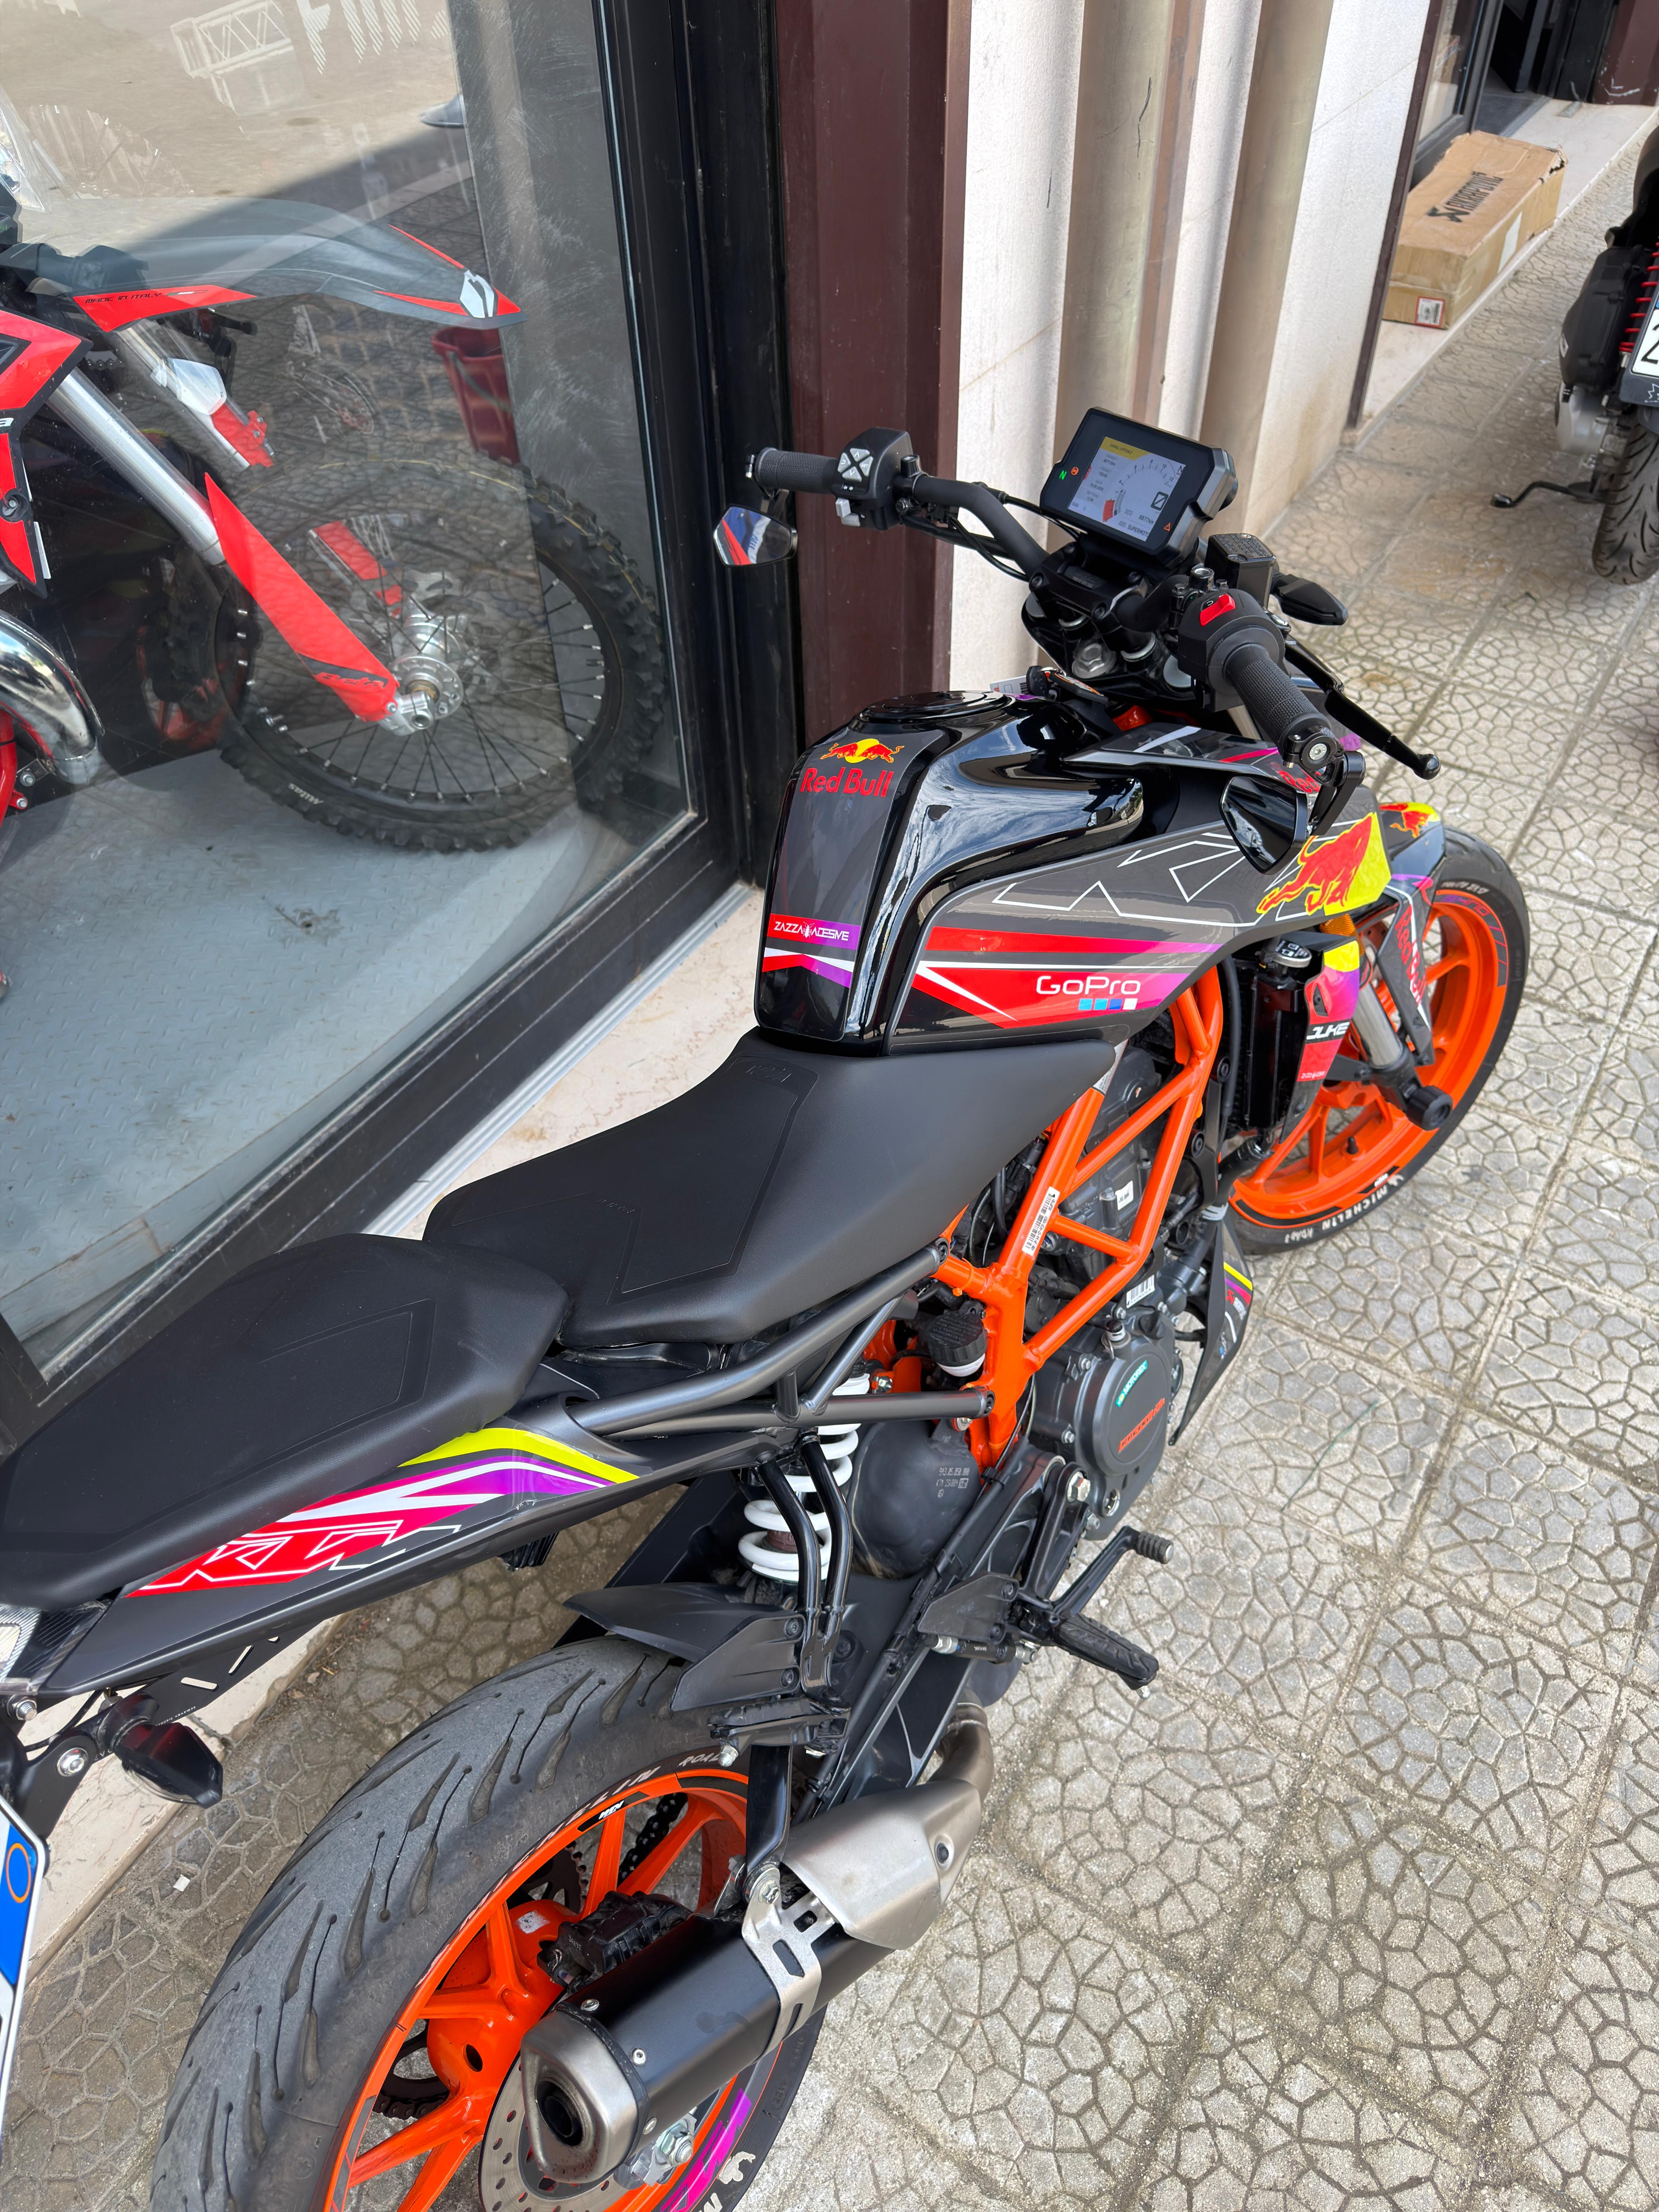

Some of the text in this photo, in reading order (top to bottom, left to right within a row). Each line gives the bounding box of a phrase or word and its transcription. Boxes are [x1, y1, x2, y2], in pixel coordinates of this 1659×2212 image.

[800, 767, 894, 798] Red Bull
[1395, 903, 1417, 965] Red
[1036, 976, 1141, 995] GoPro
[1322, 1185, 1387, 1230] MICHELIN
[1123, 1363, 1145, 1394] MOTOREX
